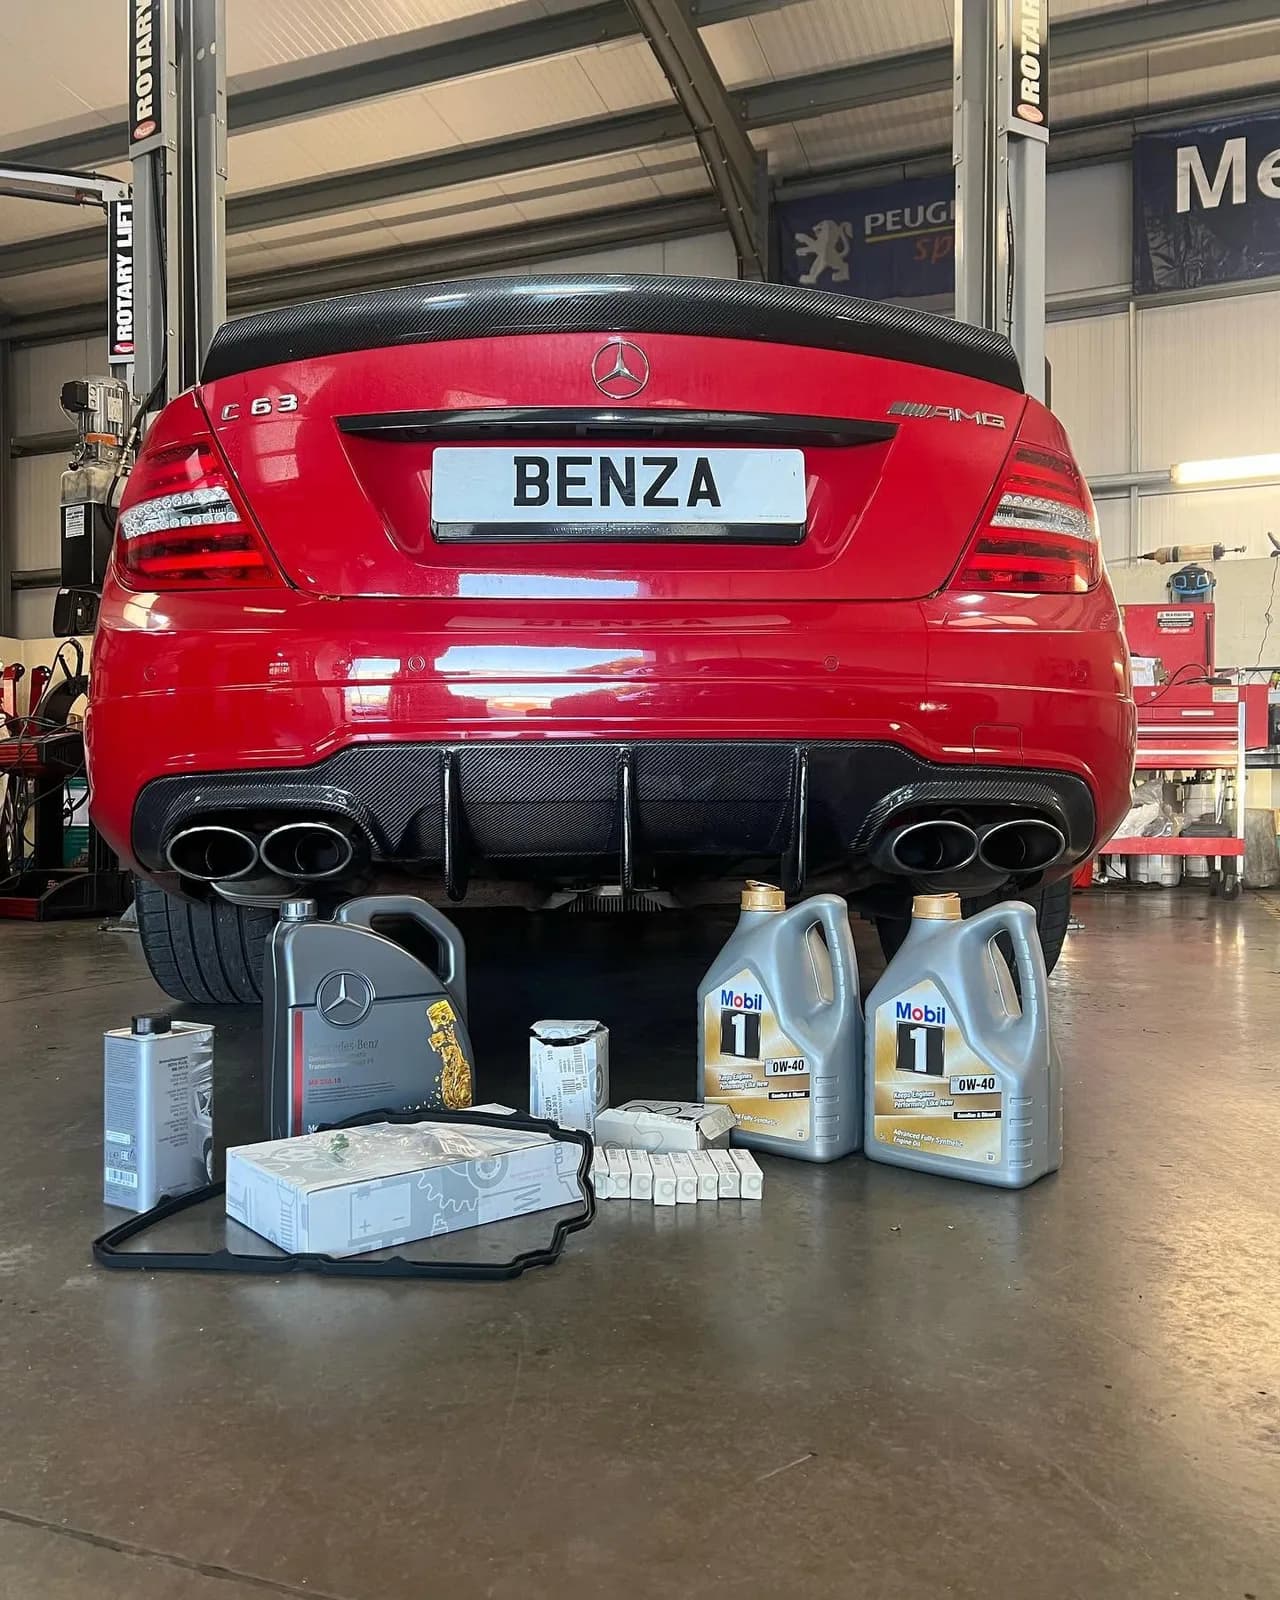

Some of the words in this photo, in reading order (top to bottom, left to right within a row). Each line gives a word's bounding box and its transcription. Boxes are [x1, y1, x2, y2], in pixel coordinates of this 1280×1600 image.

[136, 0, 153, 121] ROTARY
[116, 202, 133, 248] LIFT
[865, 200, 955, 235] PEUG
[116, 254, 133, 341] ROTARY
[221, 403, 240, 420] C
[251, 393, 298, 415] 63
[513, 456, 721, 507] BENZA
[720, 990, 762, 1011] Mobil
[896, 1001, 946, 1024] Mobil
[731, 1013, 746, 1056] 1
[909, 1027, 927, 1072] 1
[773, 1060, 804, 1073] 0W-40
[959, 1078, 995, 1091] 0W-40
